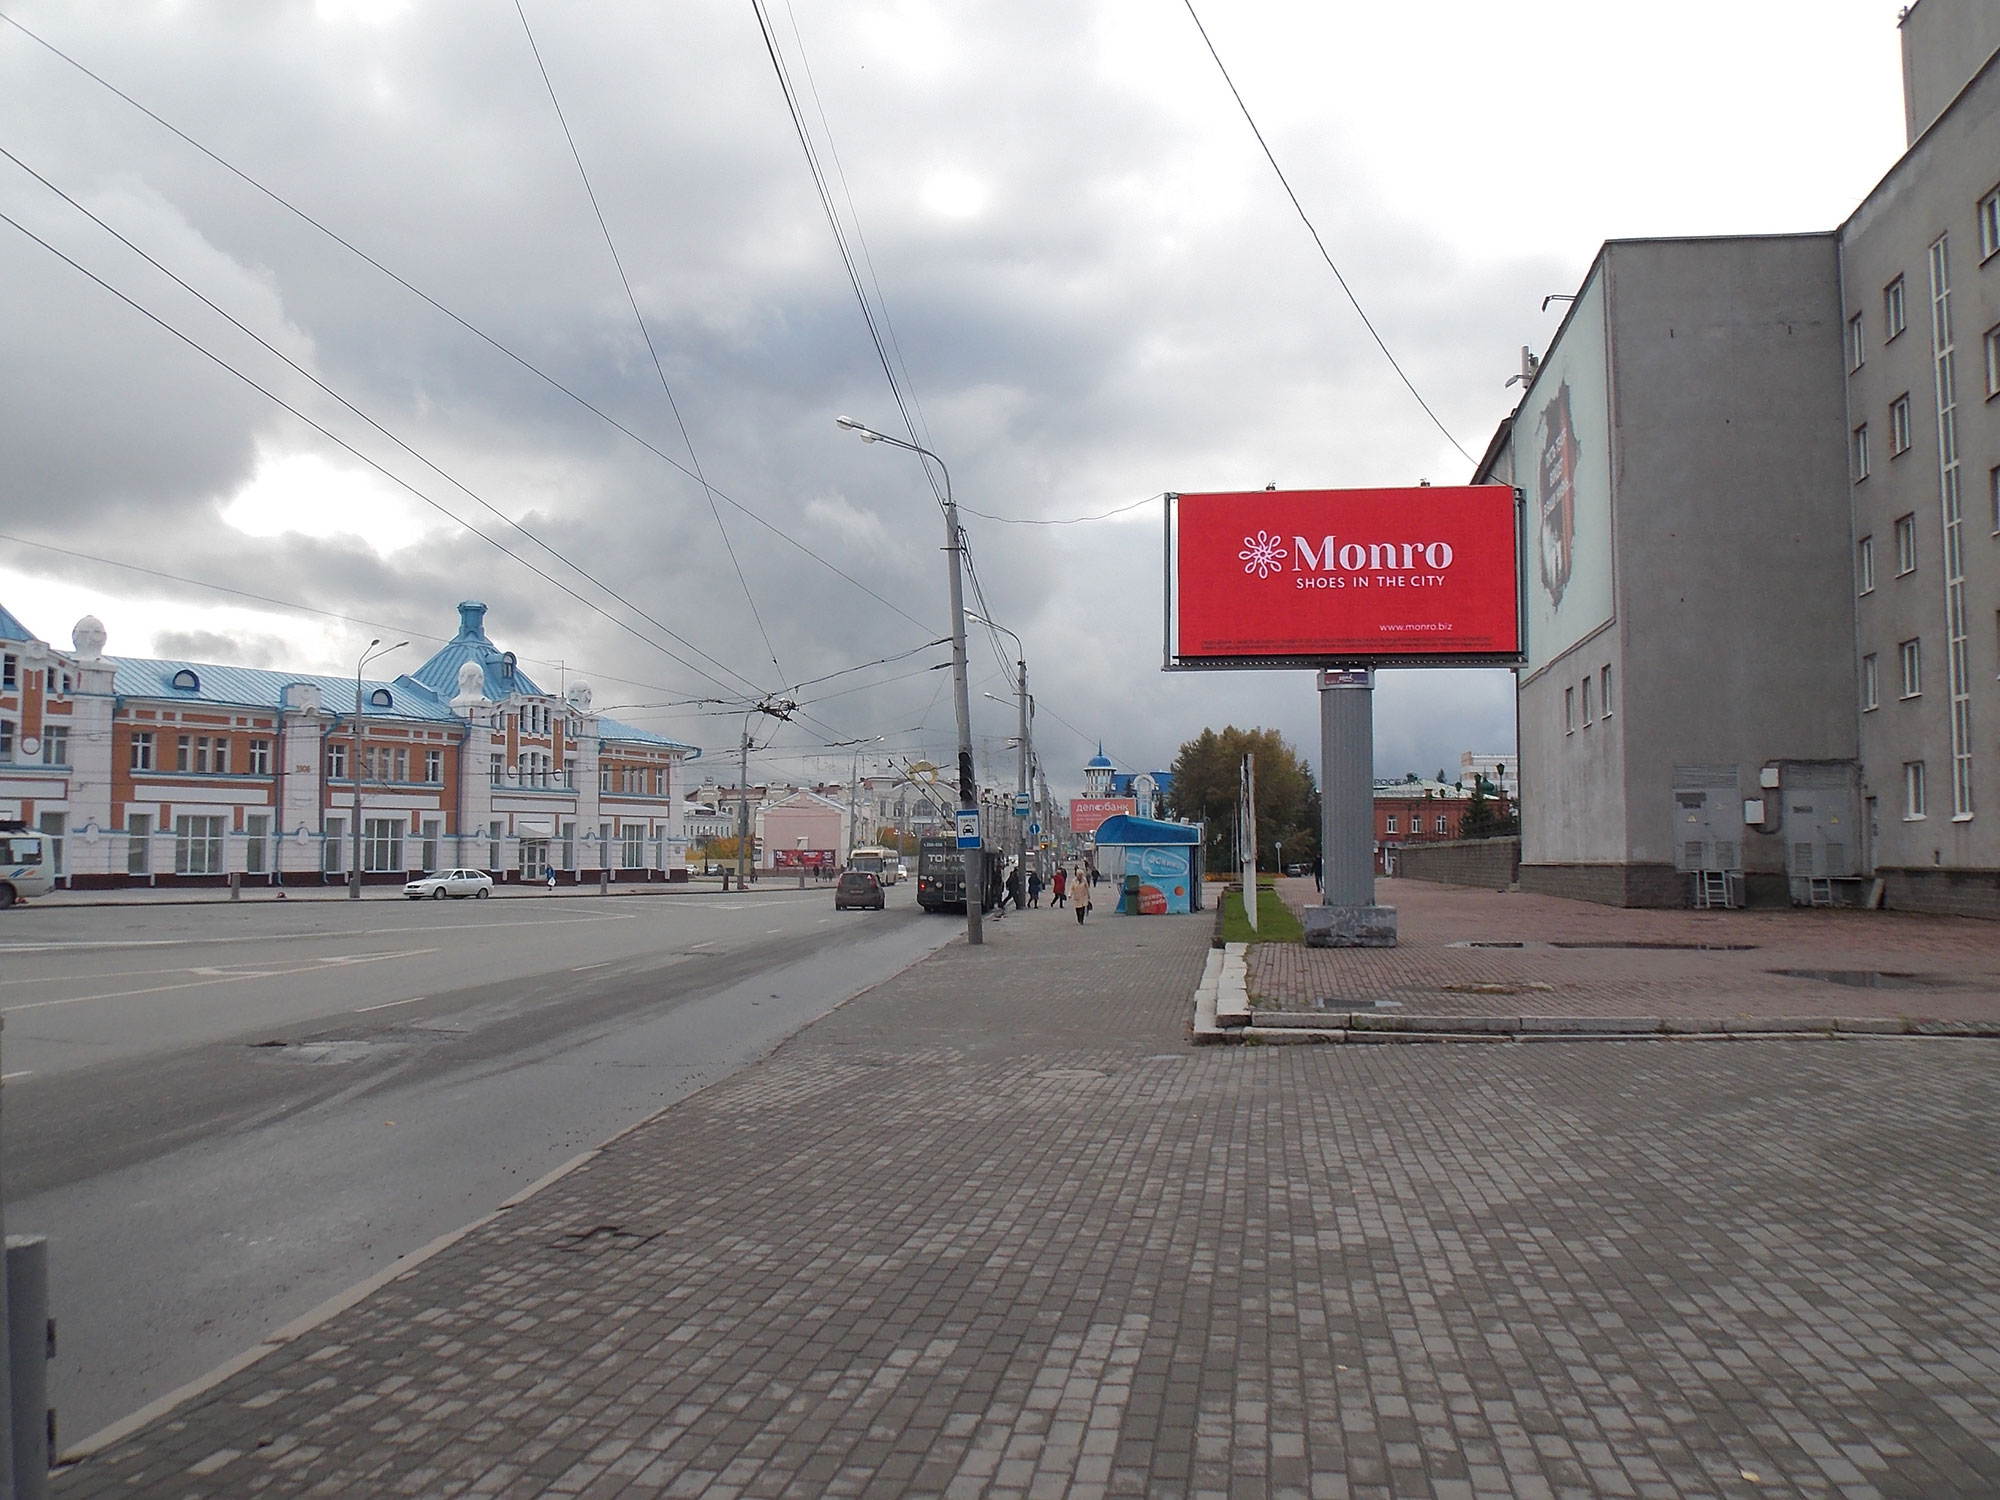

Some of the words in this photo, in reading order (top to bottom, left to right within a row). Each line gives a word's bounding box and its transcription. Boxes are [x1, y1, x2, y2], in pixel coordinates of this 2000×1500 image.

[1292, 535, 1453, 571] Monro
[1296, 577, 1345, 589] SHOES
[1353, 577, 1369, 588] IN
[1376, 576, 1406, 587] THE
[1410, 575, 1445, 587] CITY
[1379, 623, 1453, 631] www.monro.biz
